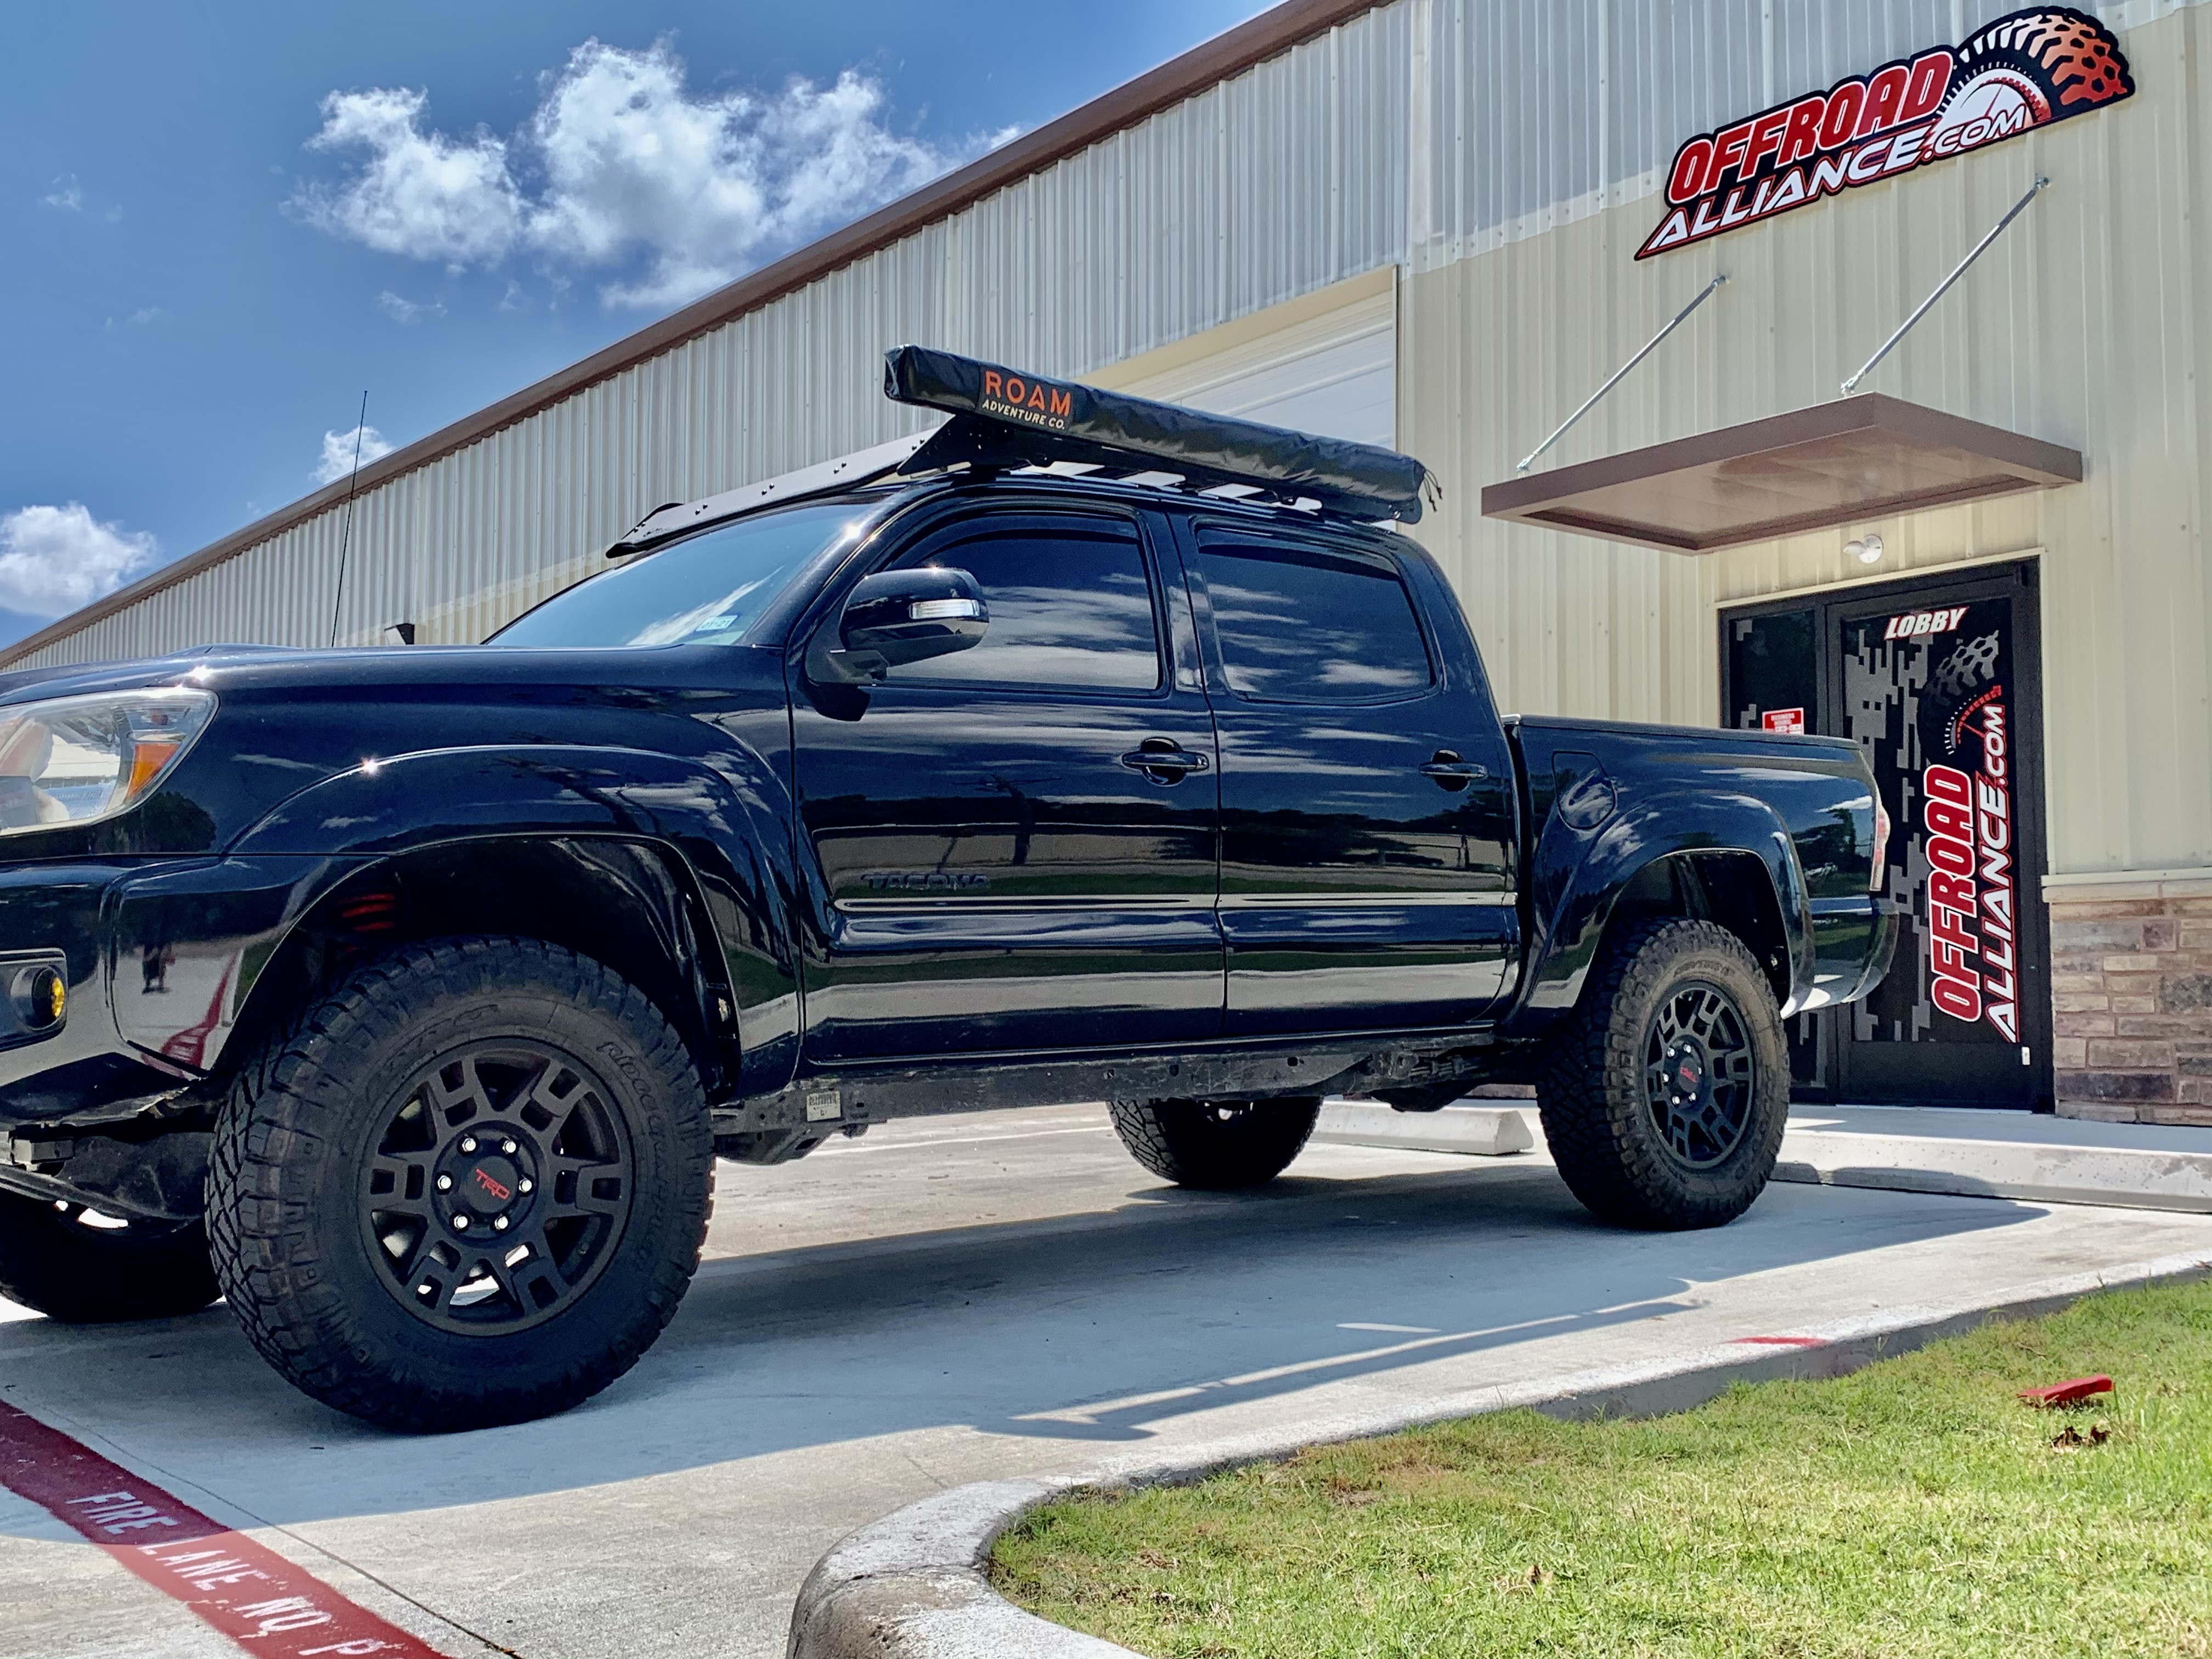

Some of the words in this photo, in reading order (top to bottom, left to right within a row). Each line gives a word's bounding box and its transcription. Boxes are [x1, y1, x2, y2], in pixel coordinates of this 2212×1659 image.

[1646, 104, 2025, 251] ALLIANCE.COM
[1669, 52, 1954, 204] OFFROAD
[982, 398, 1046, 426] ADVENTURE
[1048, 416, 1065, 430] CO.
[984, 369, 1072, 417] ROAM
[1884, 606, 1969, 640] LOBBY
[1924, 765, 1981, 1022] OFFROAD
[1980, 704, 2018, 1042] ALLIANCE.COM
[476, 1169, 510, 1200] TRD
[66, 1491, 180, 1534] FIRE
[138, 1538, 270, 1590] LANE
[233, 1596, 332, 1632] NO
